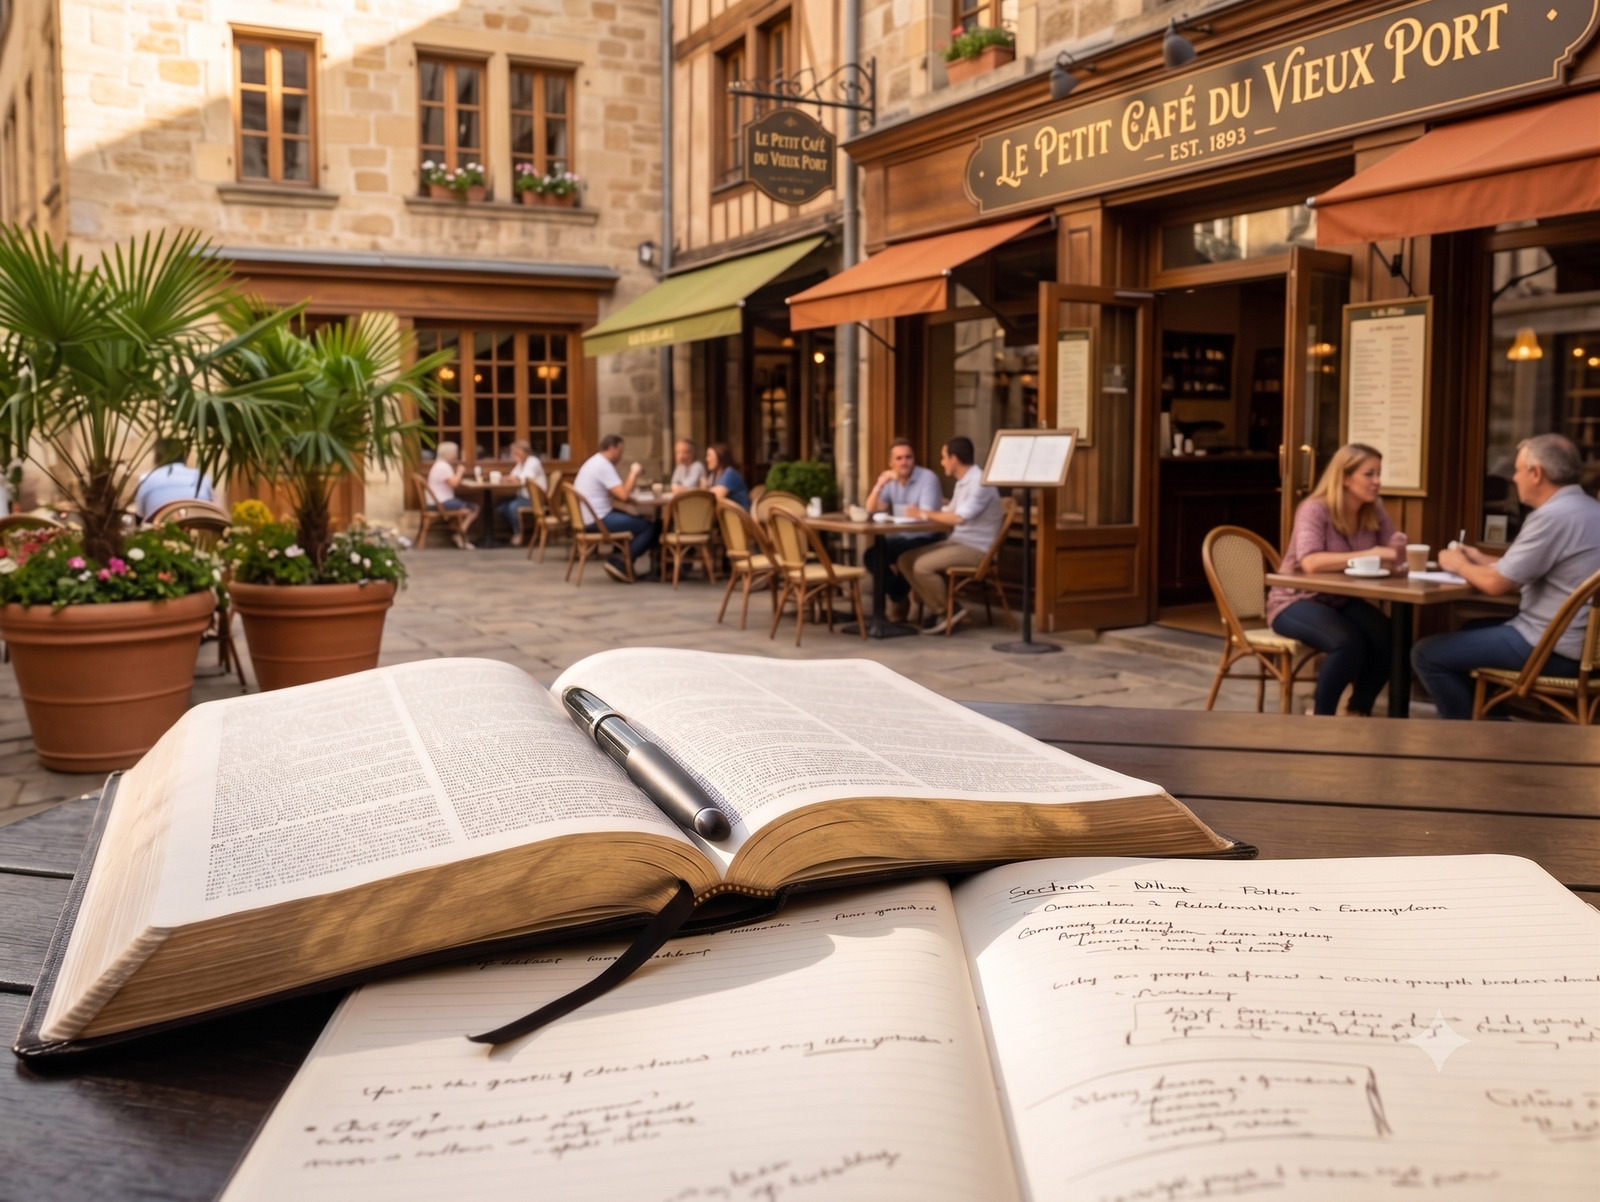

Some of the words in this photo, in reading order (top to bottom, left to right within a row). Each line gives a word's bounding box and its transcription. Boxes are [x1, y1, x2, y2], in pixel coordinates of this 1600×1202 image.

[996, 139, 1029, 188] LE
[1034, 119, 1112, 178] PETIT
[1121, 84, 1196, 151] CAFÉ
[1208, 78, 1252, 126] DU
[1262, 43, 1375, 114] VIEUX
[1384, 3, 1508, 84] PORT
[756, 130, 768, 146] LE
[771, 132, 800, 149] PETIT
[1169, 139, 1203, 161] EST.
[1209, 127, 1246, 152] 1893
[754, 152, 768, 165] DU
[770, 150, 800, 168] VIEUX
[802, 154, 827, 171] PORT
